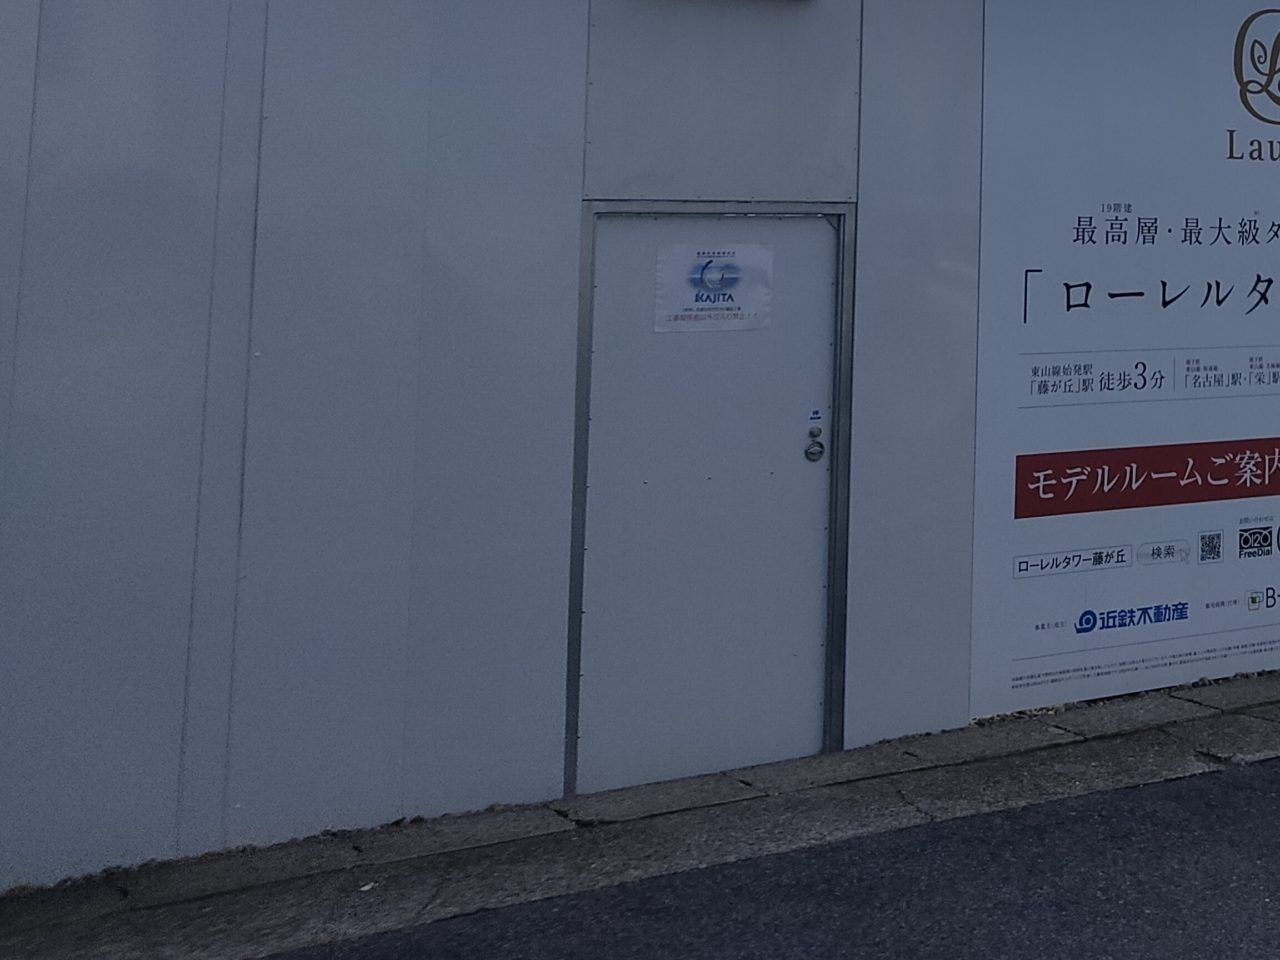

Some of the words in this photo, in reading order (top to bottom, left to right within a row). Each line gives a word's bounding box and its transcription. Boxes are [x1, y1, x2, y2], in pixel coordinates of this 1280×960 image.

[694, 289, 735, 304] KAJITA
[1098, 361, 1166, 391] 徒歩3分
[1018, 548, 1127, 573] ローレルタワー藤が丘
[1151, 545, 1176, 561] 検索
[1238, 547, 1273, 559] FreeDial
[1098, 602, 1190, 630] 近鉄不動産
